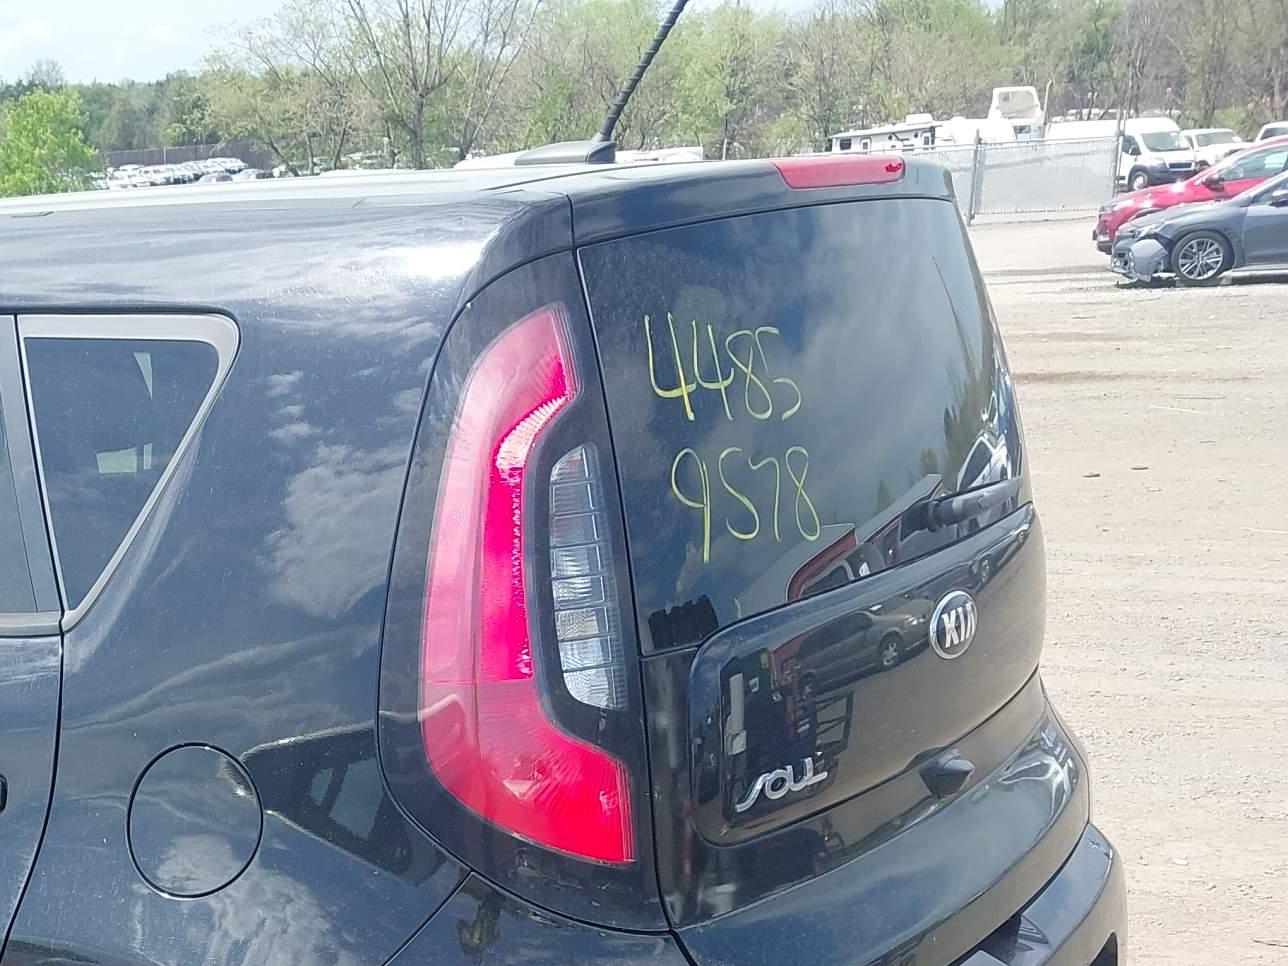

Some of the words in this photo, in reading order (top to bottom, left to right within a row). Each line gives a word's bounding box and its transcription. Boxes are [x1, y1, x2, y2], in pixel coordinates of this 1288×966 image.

[644, 311, 801, 421] 4485
[671, 446, 820, 564] 9578
[941, 600, 977, 649] KIA
[735, 757, 829, 813] SOUL
